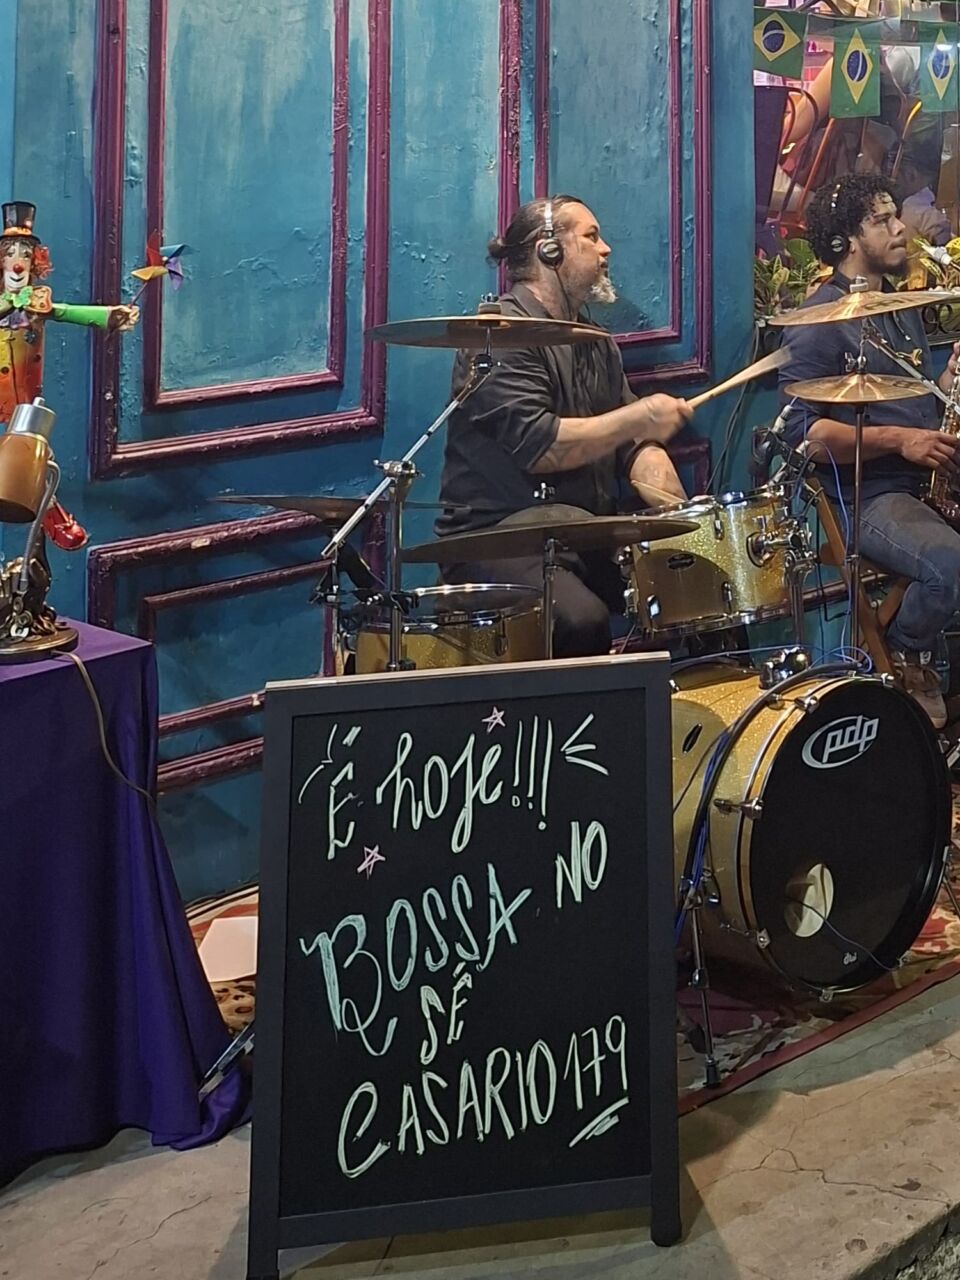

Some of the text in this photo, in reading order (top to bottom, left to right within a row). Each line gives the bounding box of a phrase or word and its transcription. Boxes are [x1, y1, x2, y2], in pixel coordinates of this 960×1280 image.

[822, 715, 879, 763] pdp
[300, 821, 608, 1057] BOSSA NO
